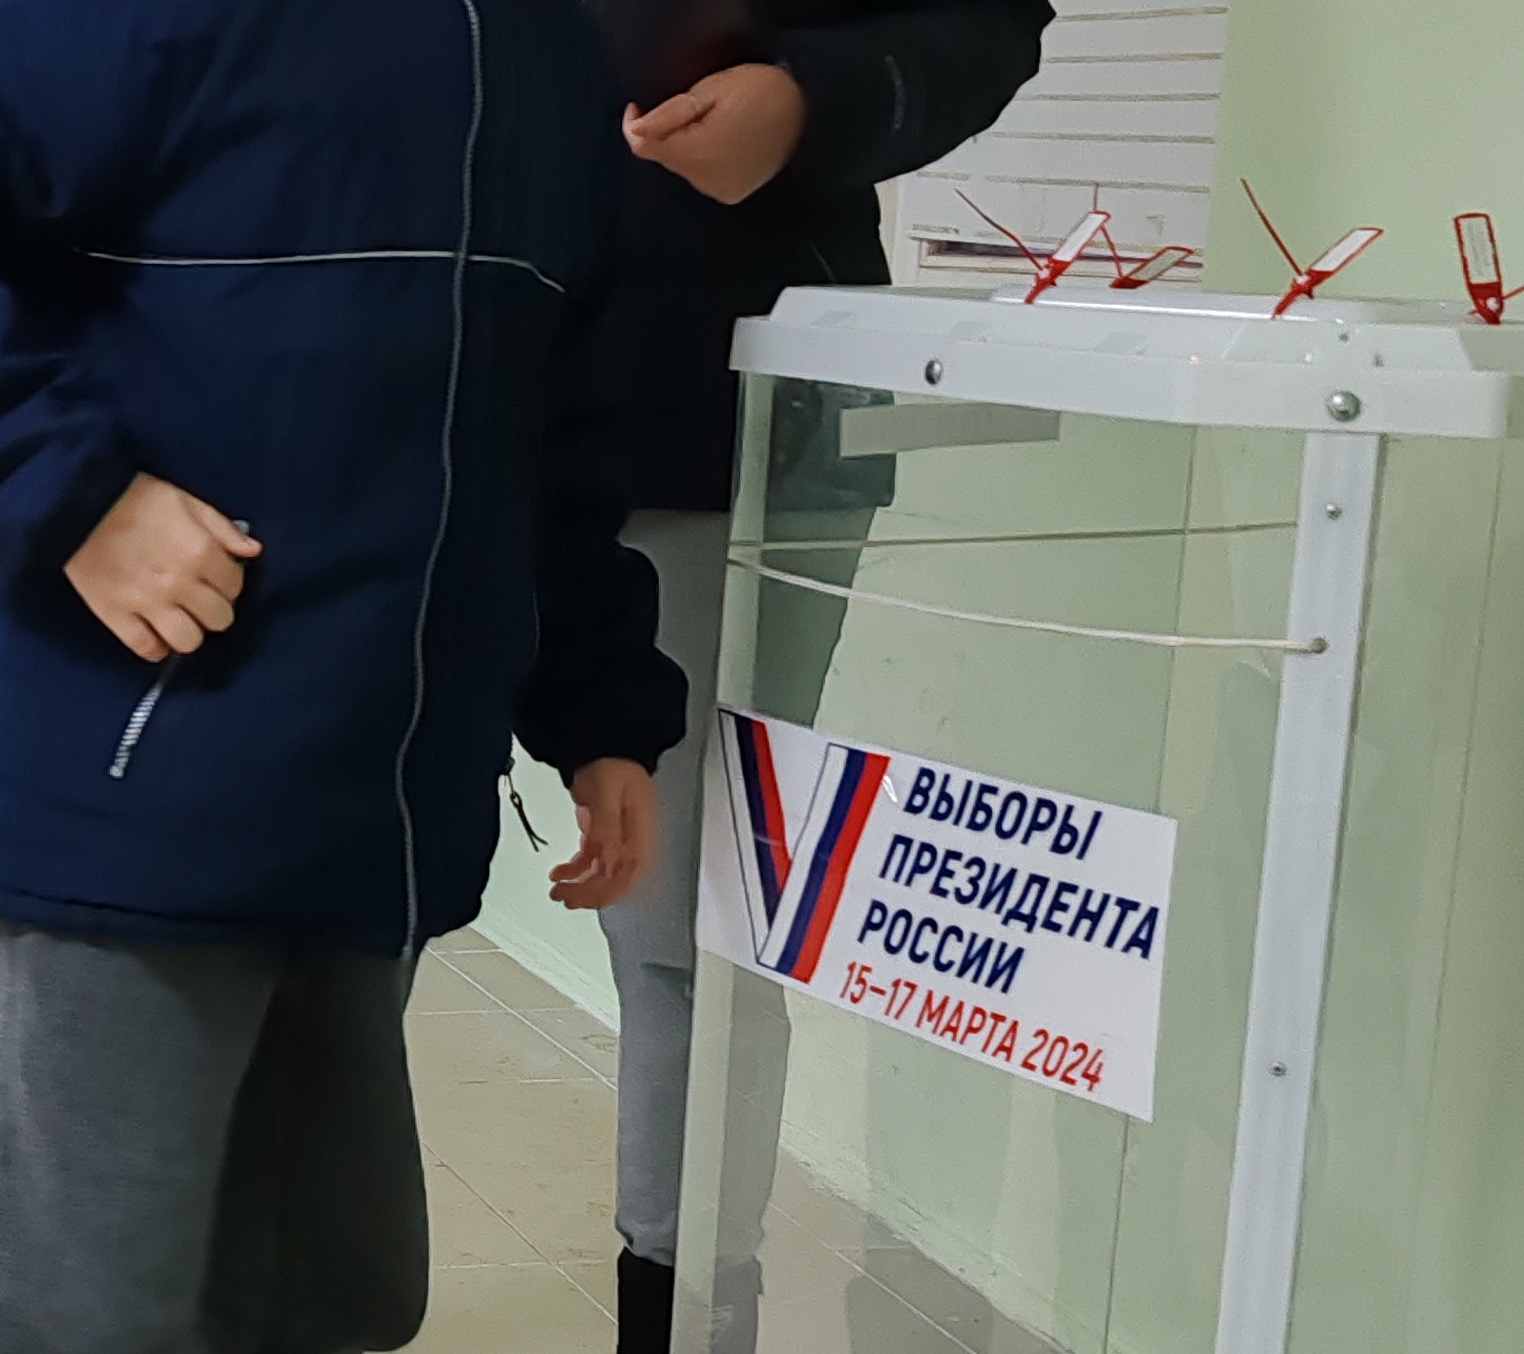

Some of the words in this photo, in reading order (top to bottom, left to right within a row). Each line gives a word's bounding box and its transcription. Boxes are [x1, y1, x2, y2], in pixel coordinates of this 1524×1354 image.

[903, 766, 1103, 860] ВЫБОРЫ
[857, 898, 1025, 995] РОССИИ
[879, 834, 1161, 960] ПРЕЗИДЕНТА
[914, 989, 1020, 1063] МАРТА
[1021, 1027, 1105, 1093] 2024
